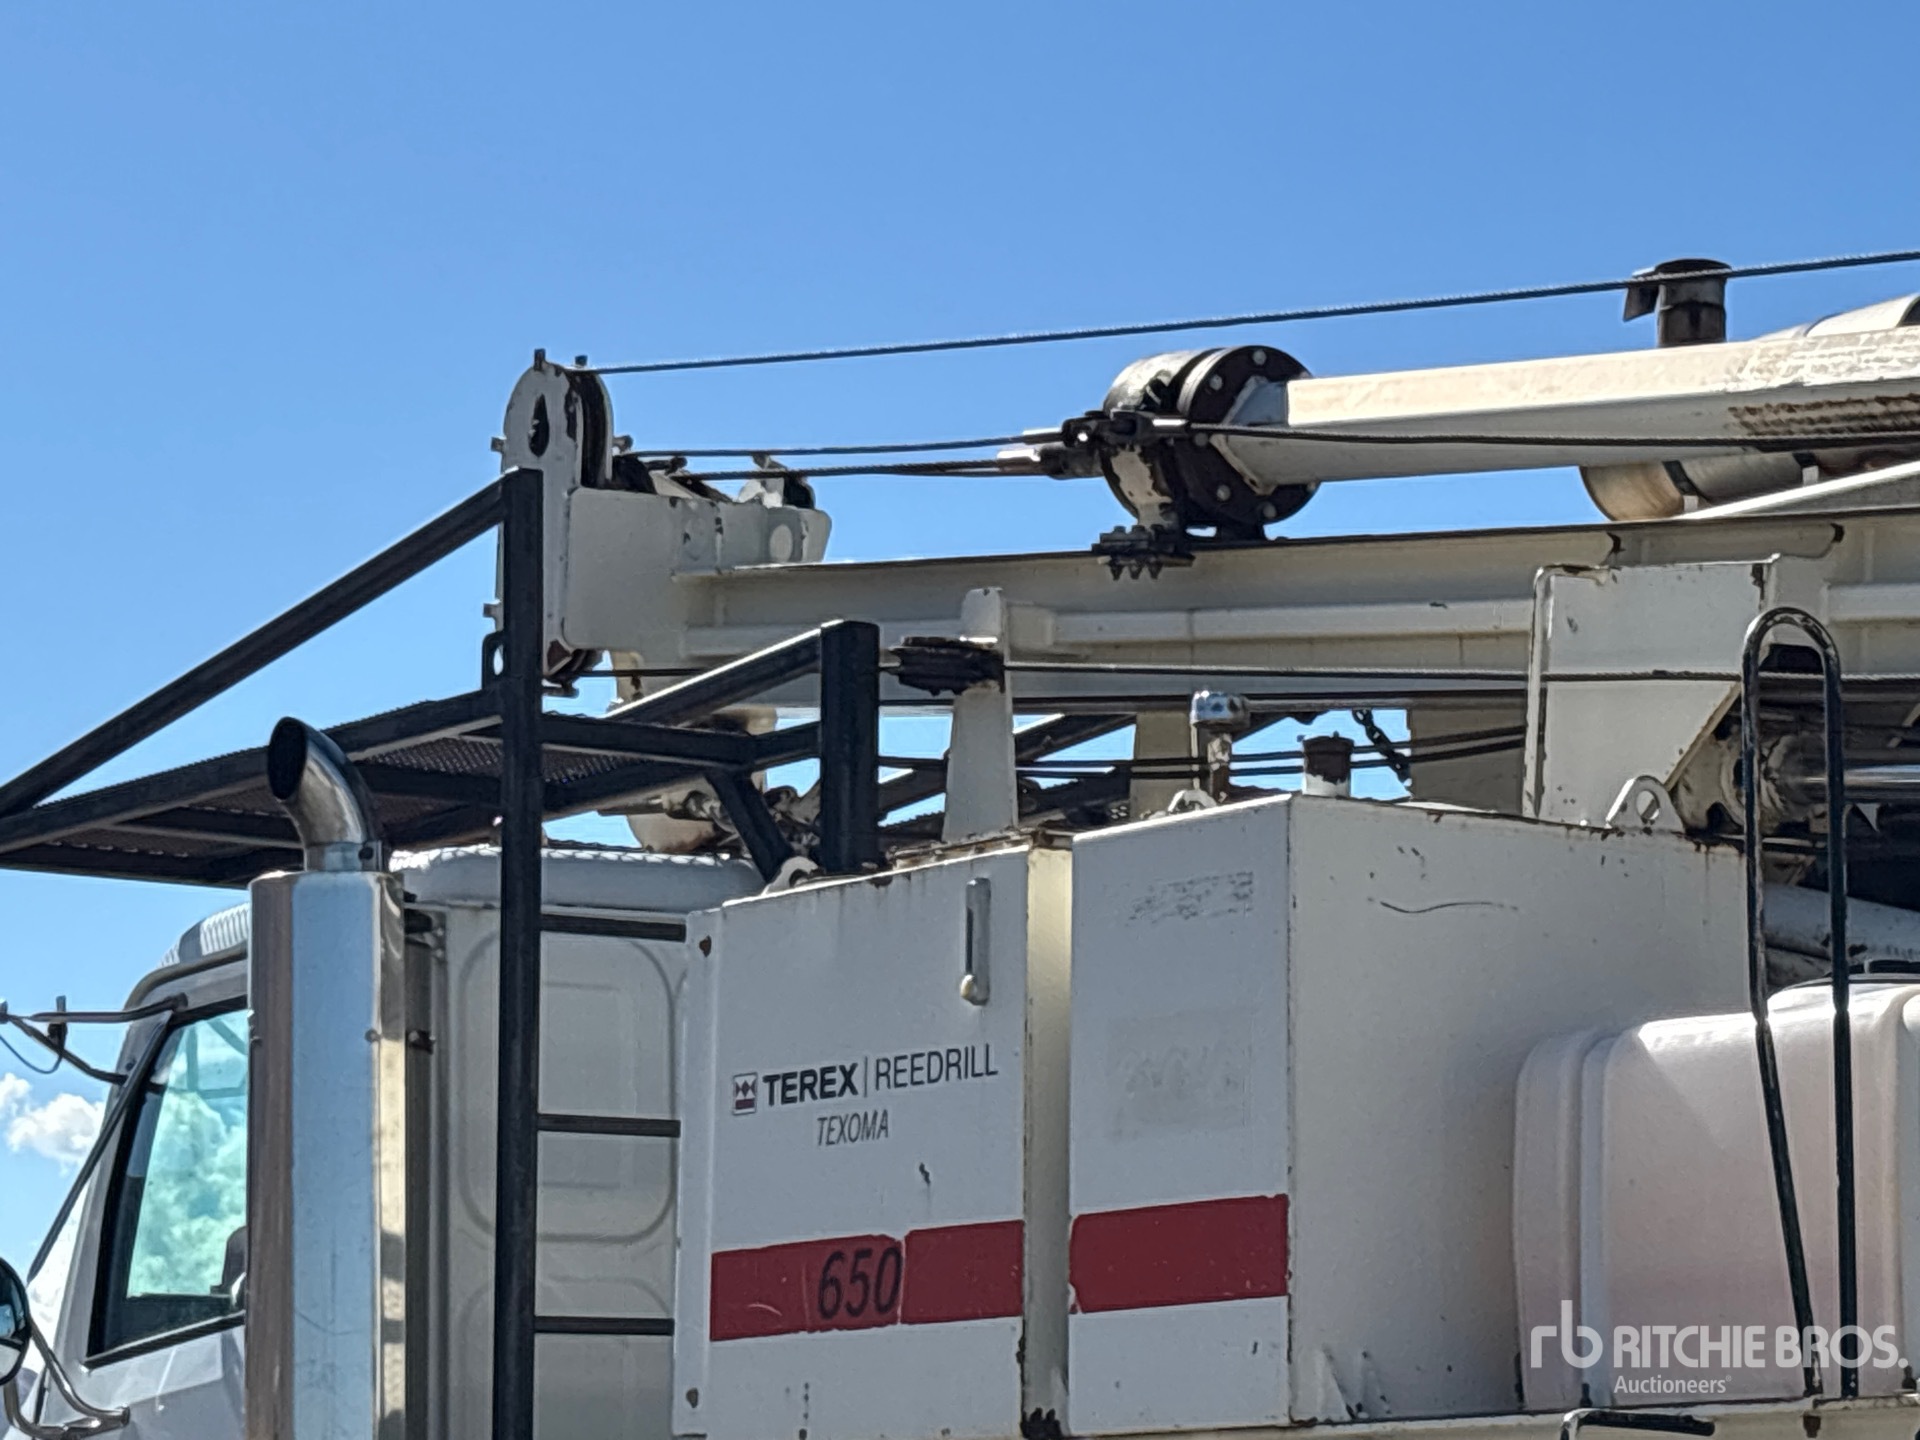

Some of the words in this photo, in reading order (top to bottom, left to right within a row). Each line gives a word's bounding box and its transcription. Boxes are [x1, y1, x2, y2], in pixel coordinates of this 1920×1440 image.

[763, 1062, 859, 1107] TEREX
[875, 1043, 999, 1091] REEDRILL
[817, 1109, 889, 1146] TEXOMA
[818, 1246, 903, 1321] 650
